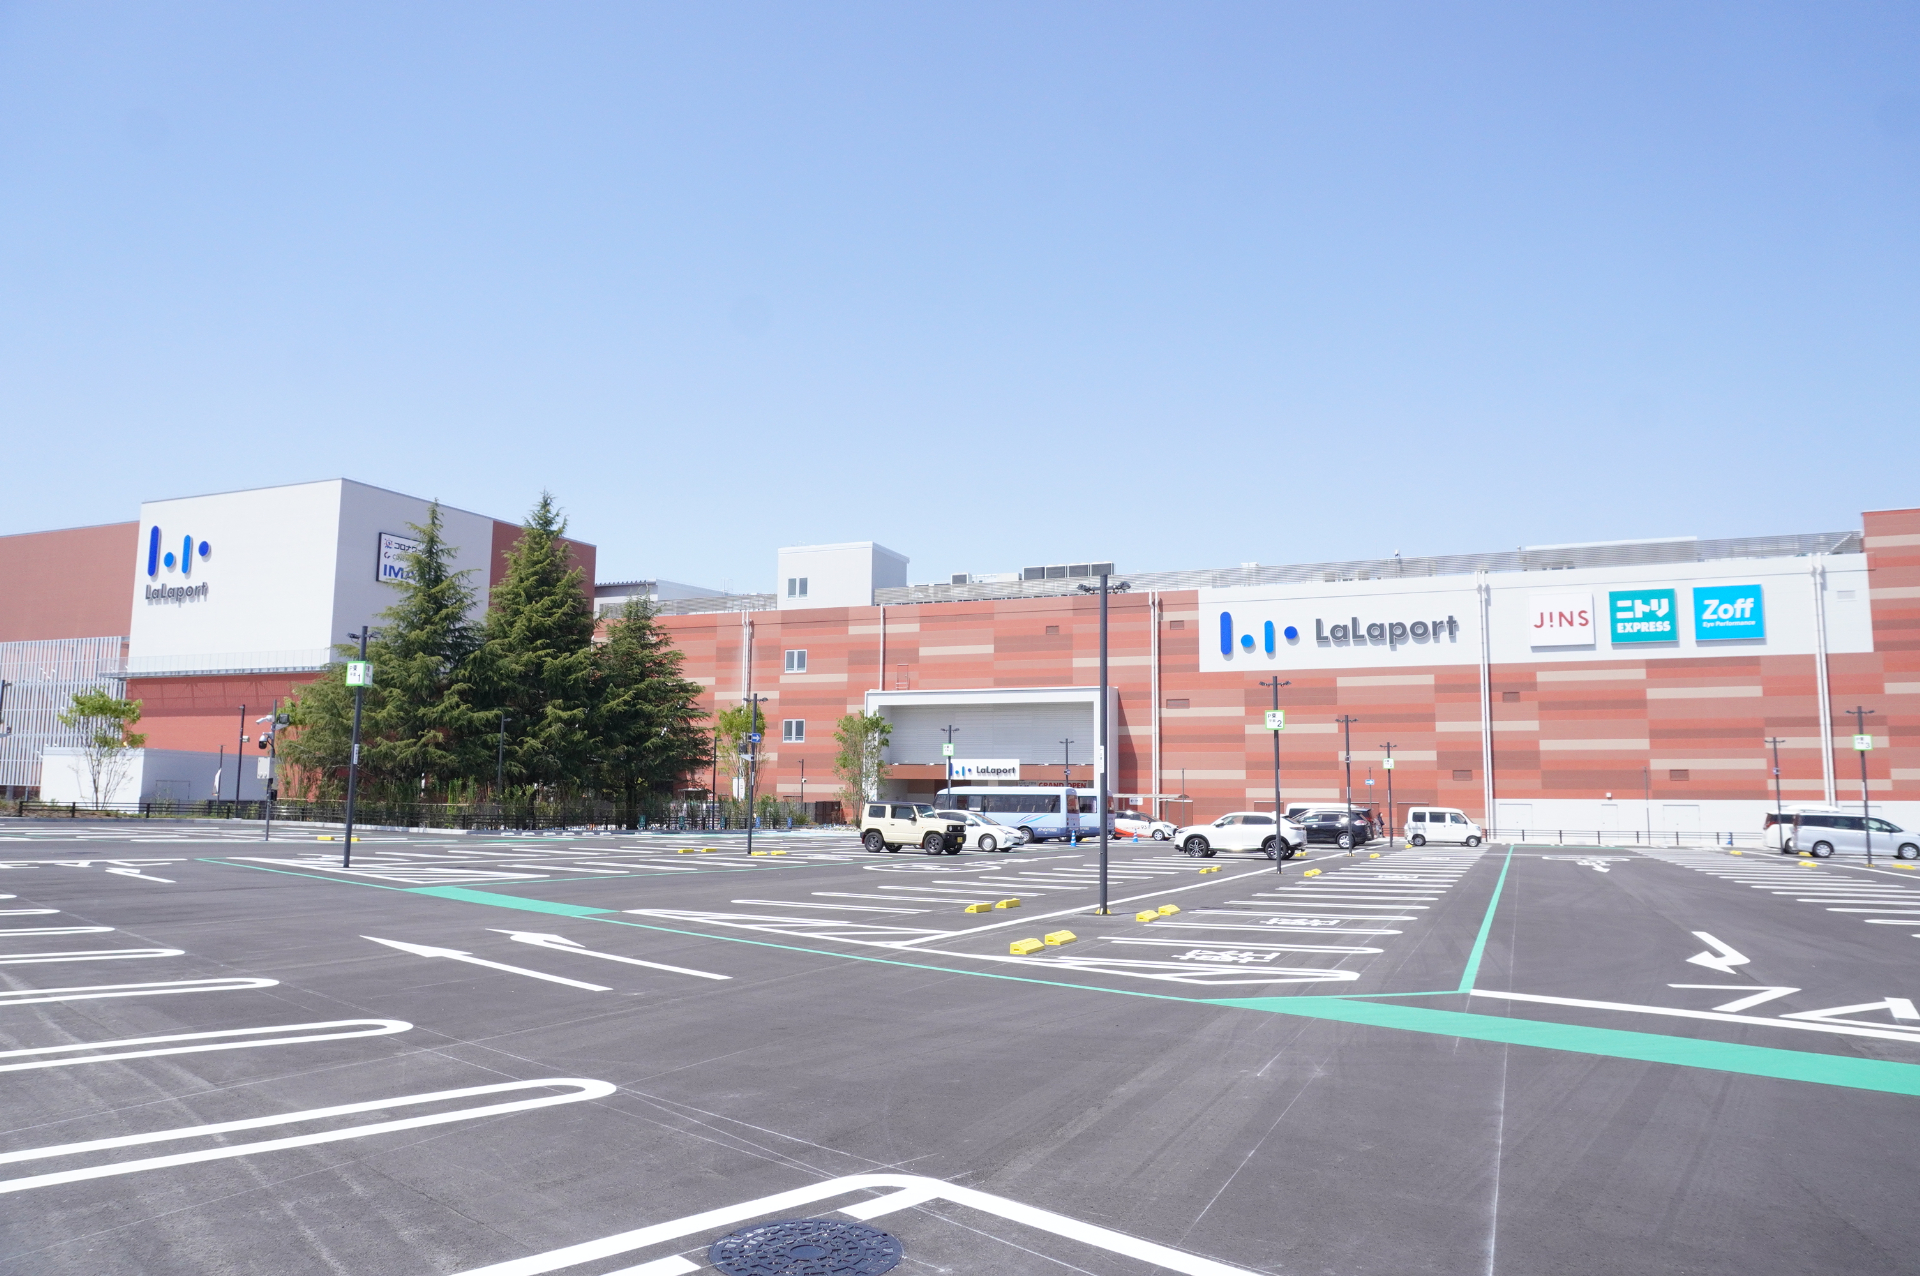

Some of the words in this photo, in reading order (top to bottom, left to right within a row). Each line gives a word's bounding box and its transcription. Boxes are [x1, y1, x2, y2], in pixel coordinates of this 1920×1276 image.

[394, 541, 422, 553] コロナワ
[383, 564, 421, 582] IMA
[145, 582, 206, 602] LaLaport
[1616, 598, 1669, 618] ニトリ
[1702, 598, 1754, 619] Zoff
[1315, 615, 1457, 645] LaLaport
[1617, 621, 1671, 633] EXPRESS
[1277, 719, 1282, 727] 2
[976, 766, 1016, 776] LaLaport
